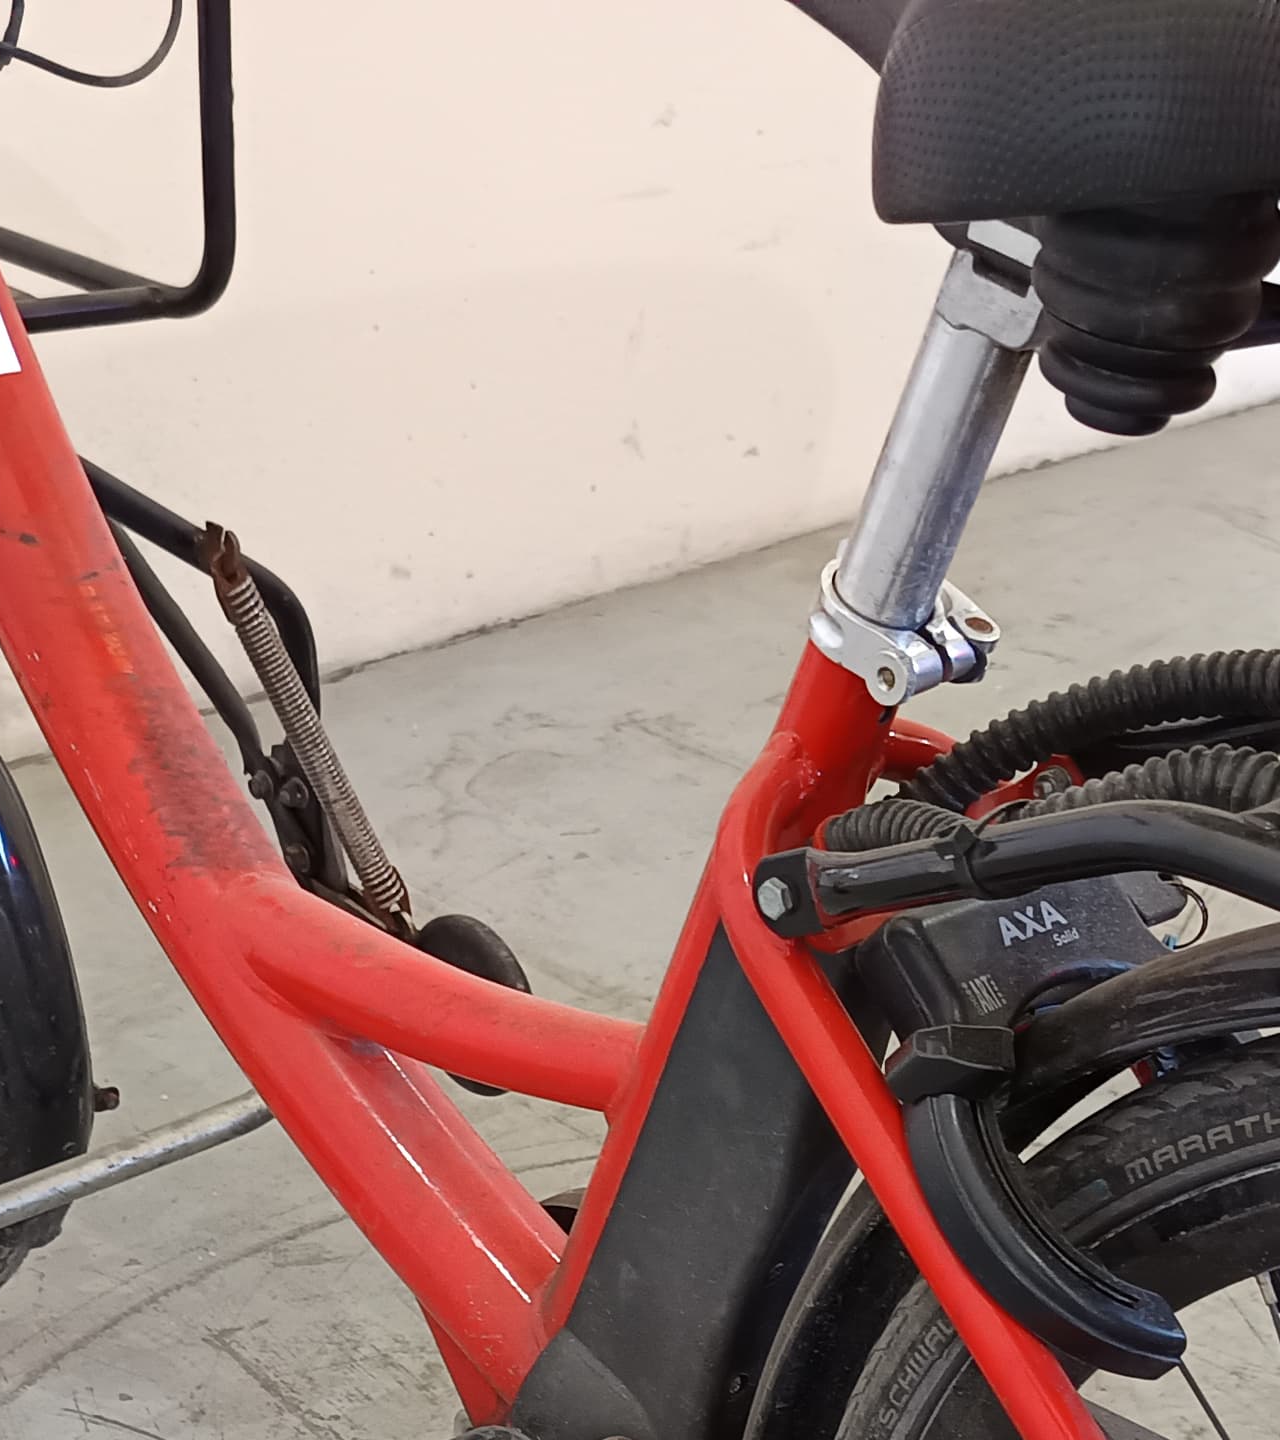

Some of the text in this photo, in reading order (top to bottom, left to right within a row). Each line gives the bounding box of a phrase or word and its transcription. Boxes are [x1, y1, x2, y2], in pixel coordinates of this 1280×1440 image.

[998, 900, 1069, 947] AXA
[1053, 926, 1080, 947] Solid
[878, 1319, 954, 1430] SCHWAL
